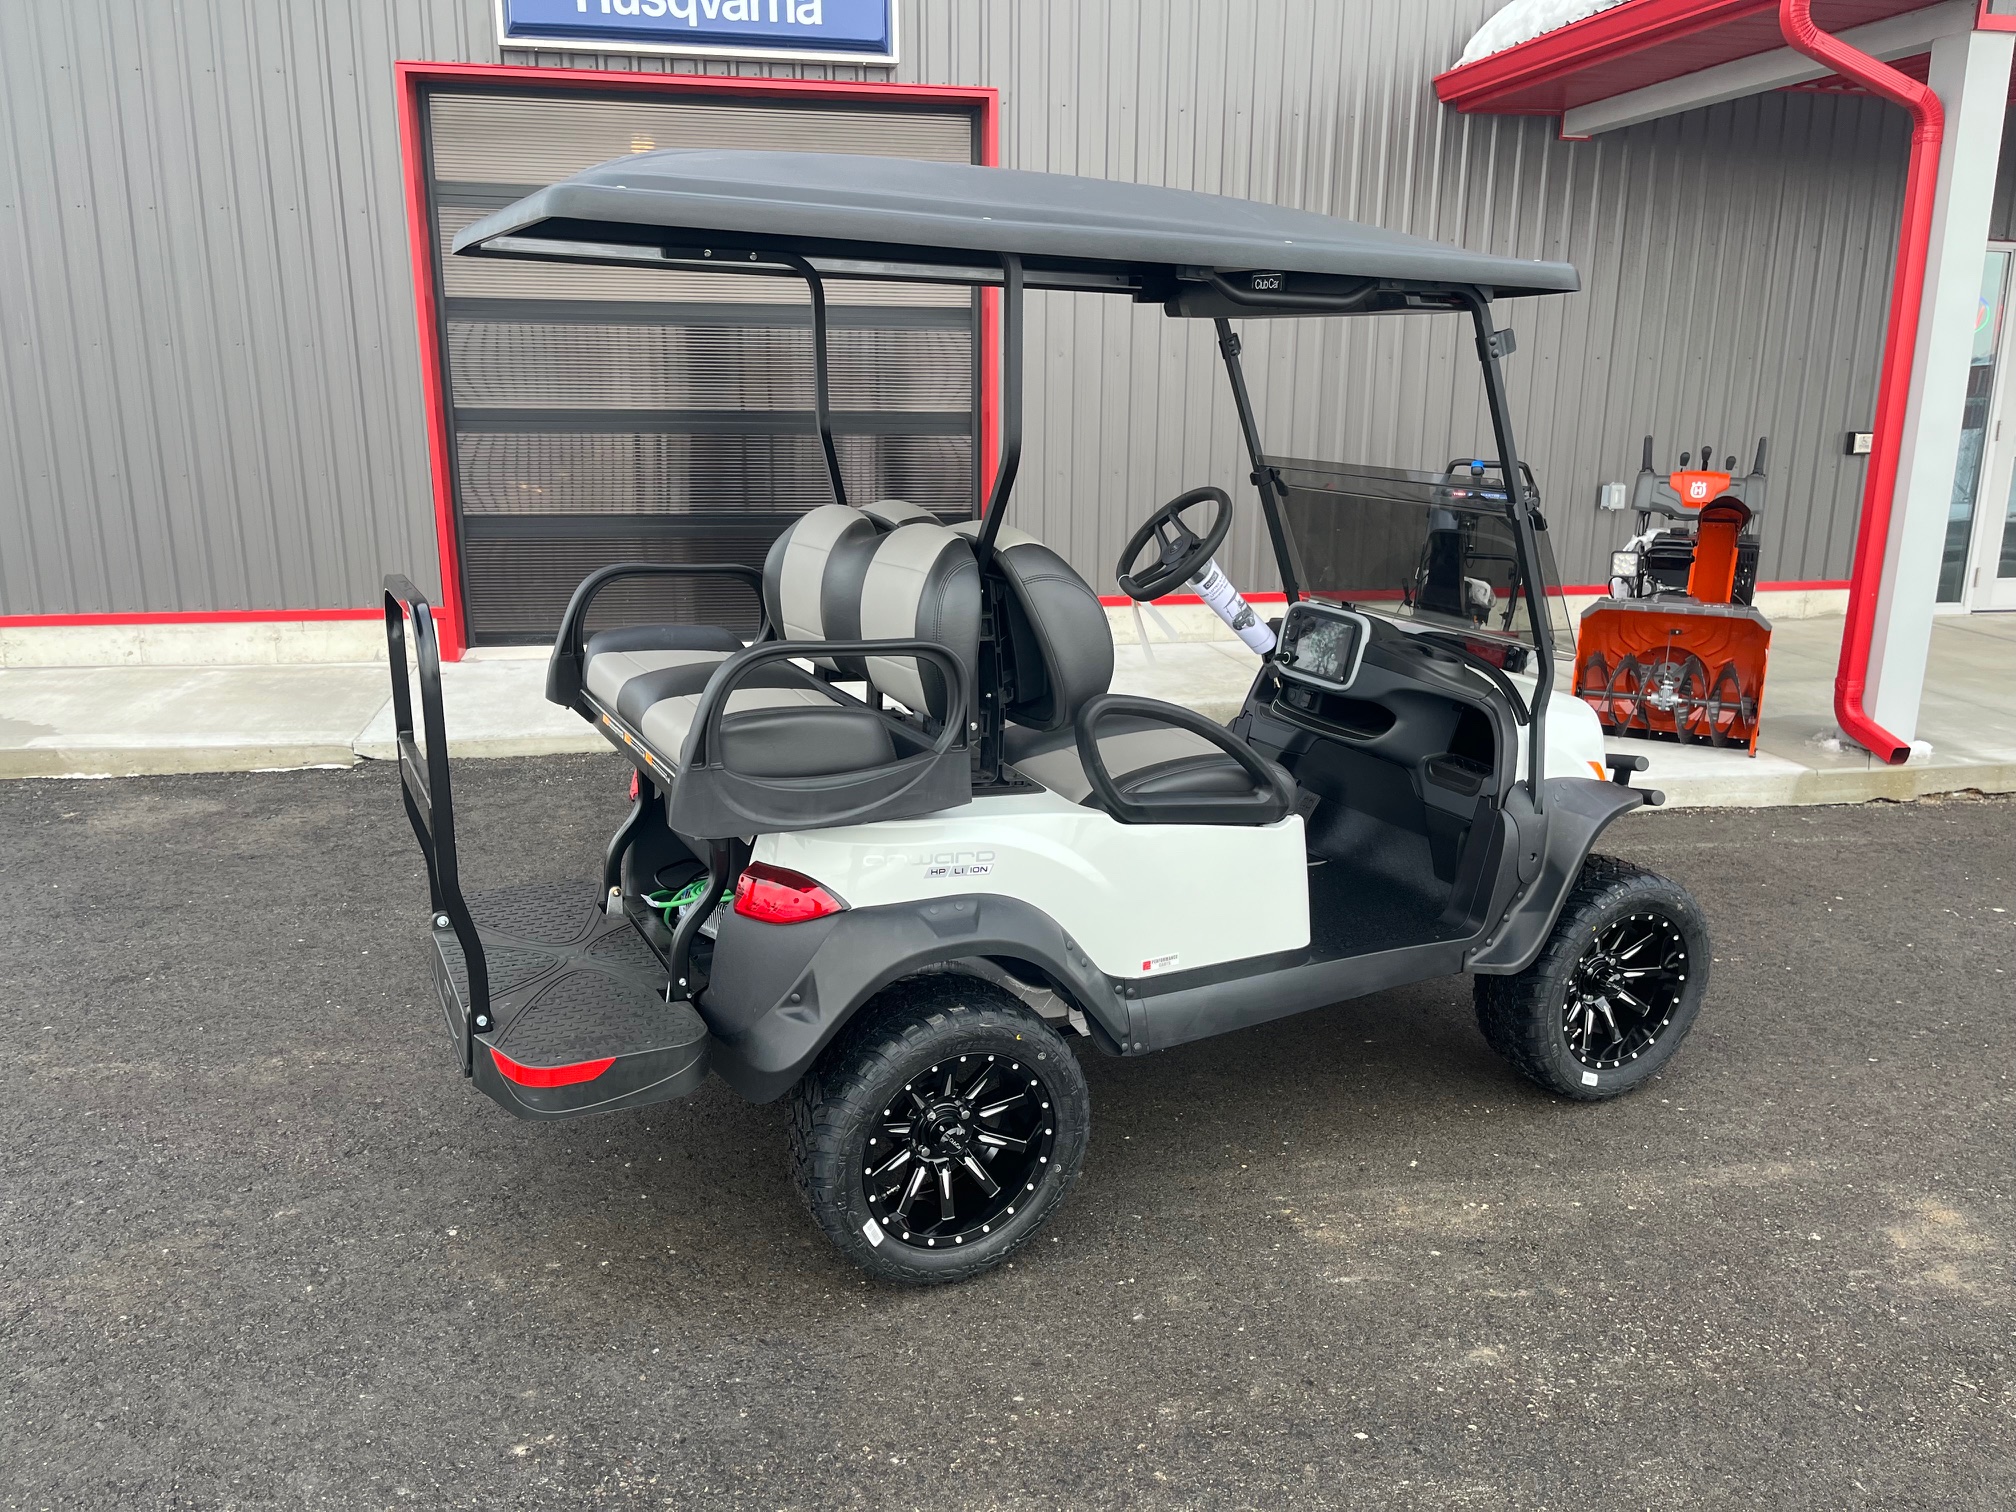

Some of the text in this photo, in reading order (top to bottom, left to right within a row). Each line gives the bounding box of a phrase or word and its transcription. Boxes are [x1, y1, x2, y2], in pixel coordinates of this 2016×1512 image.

[1268, 278, 1279, 289] Car
[930, 865, 988, 876] HP LI ION
